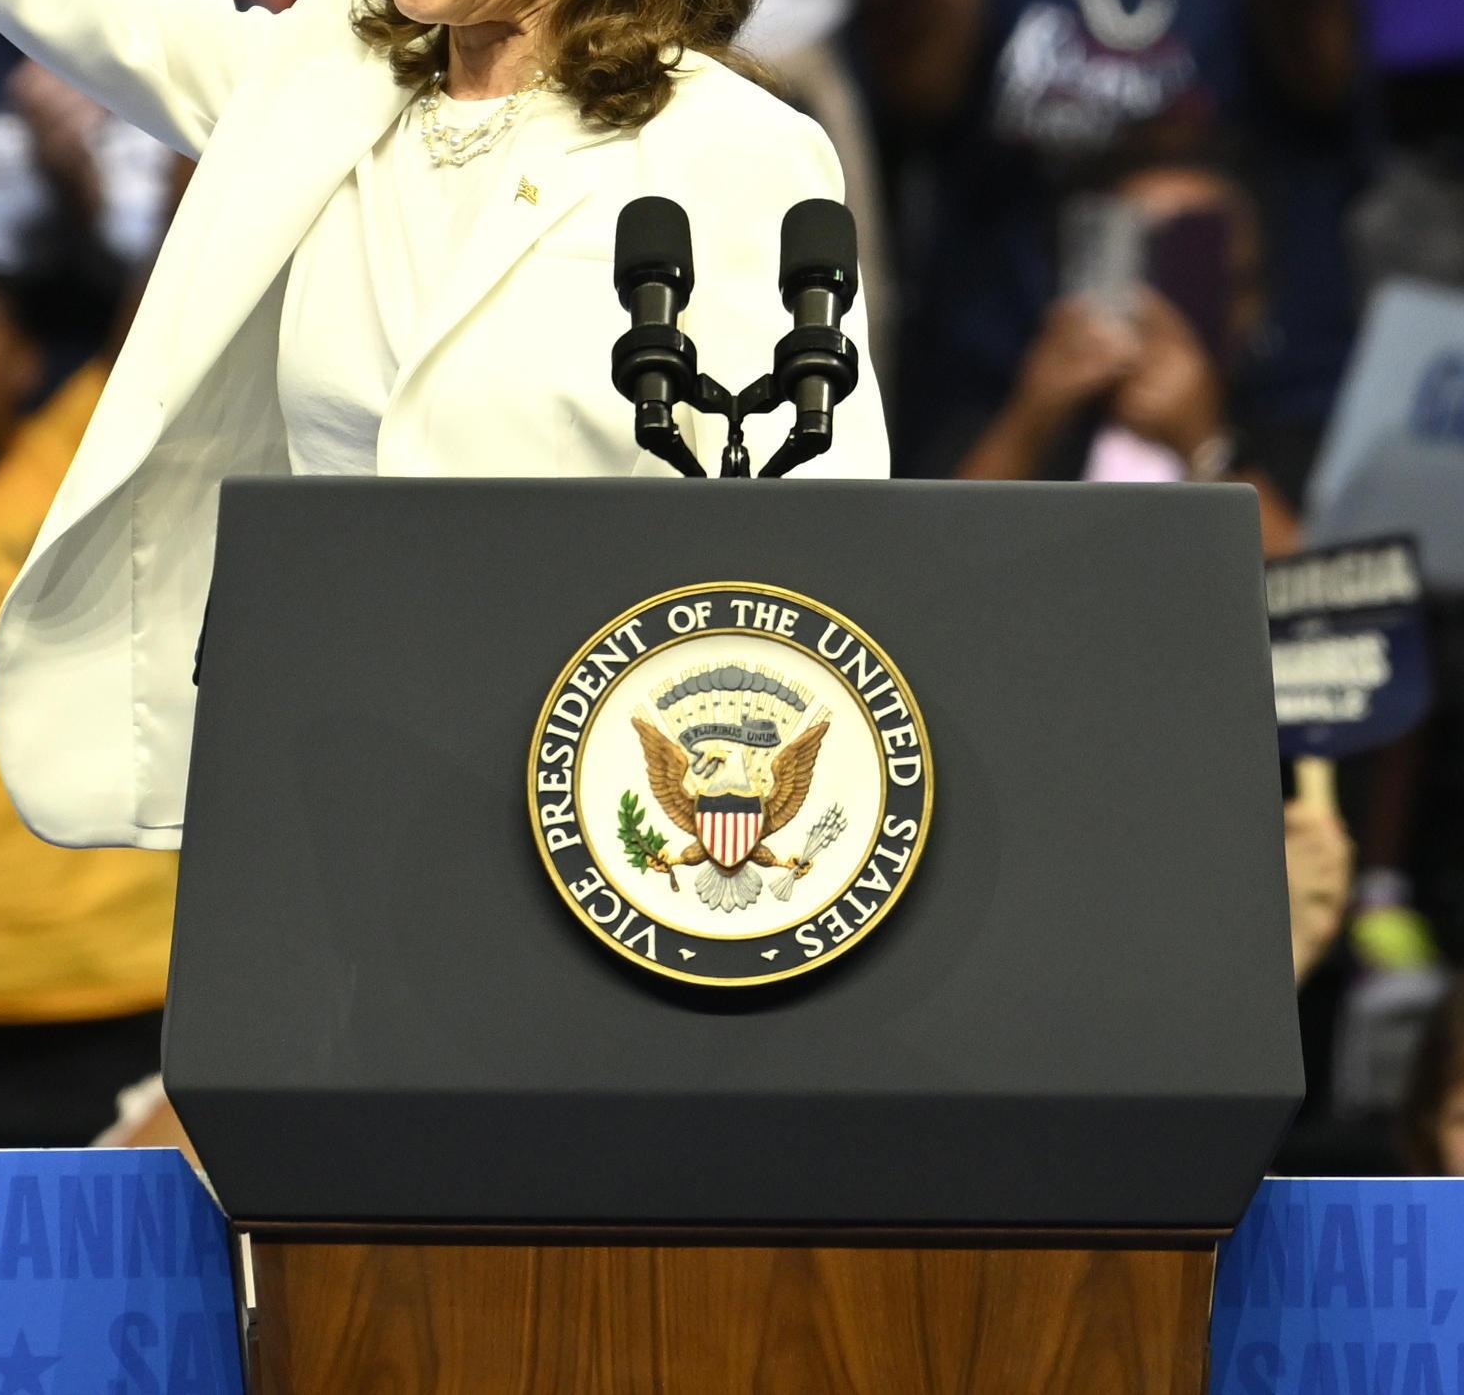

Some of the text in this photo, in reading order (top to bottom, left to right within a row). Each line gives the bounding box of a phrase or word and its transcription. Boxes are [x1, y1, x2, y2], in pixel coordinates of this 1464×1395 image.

[538, 599, 922, 962] VICE PRESIDENT OF THE UNITED STATES
